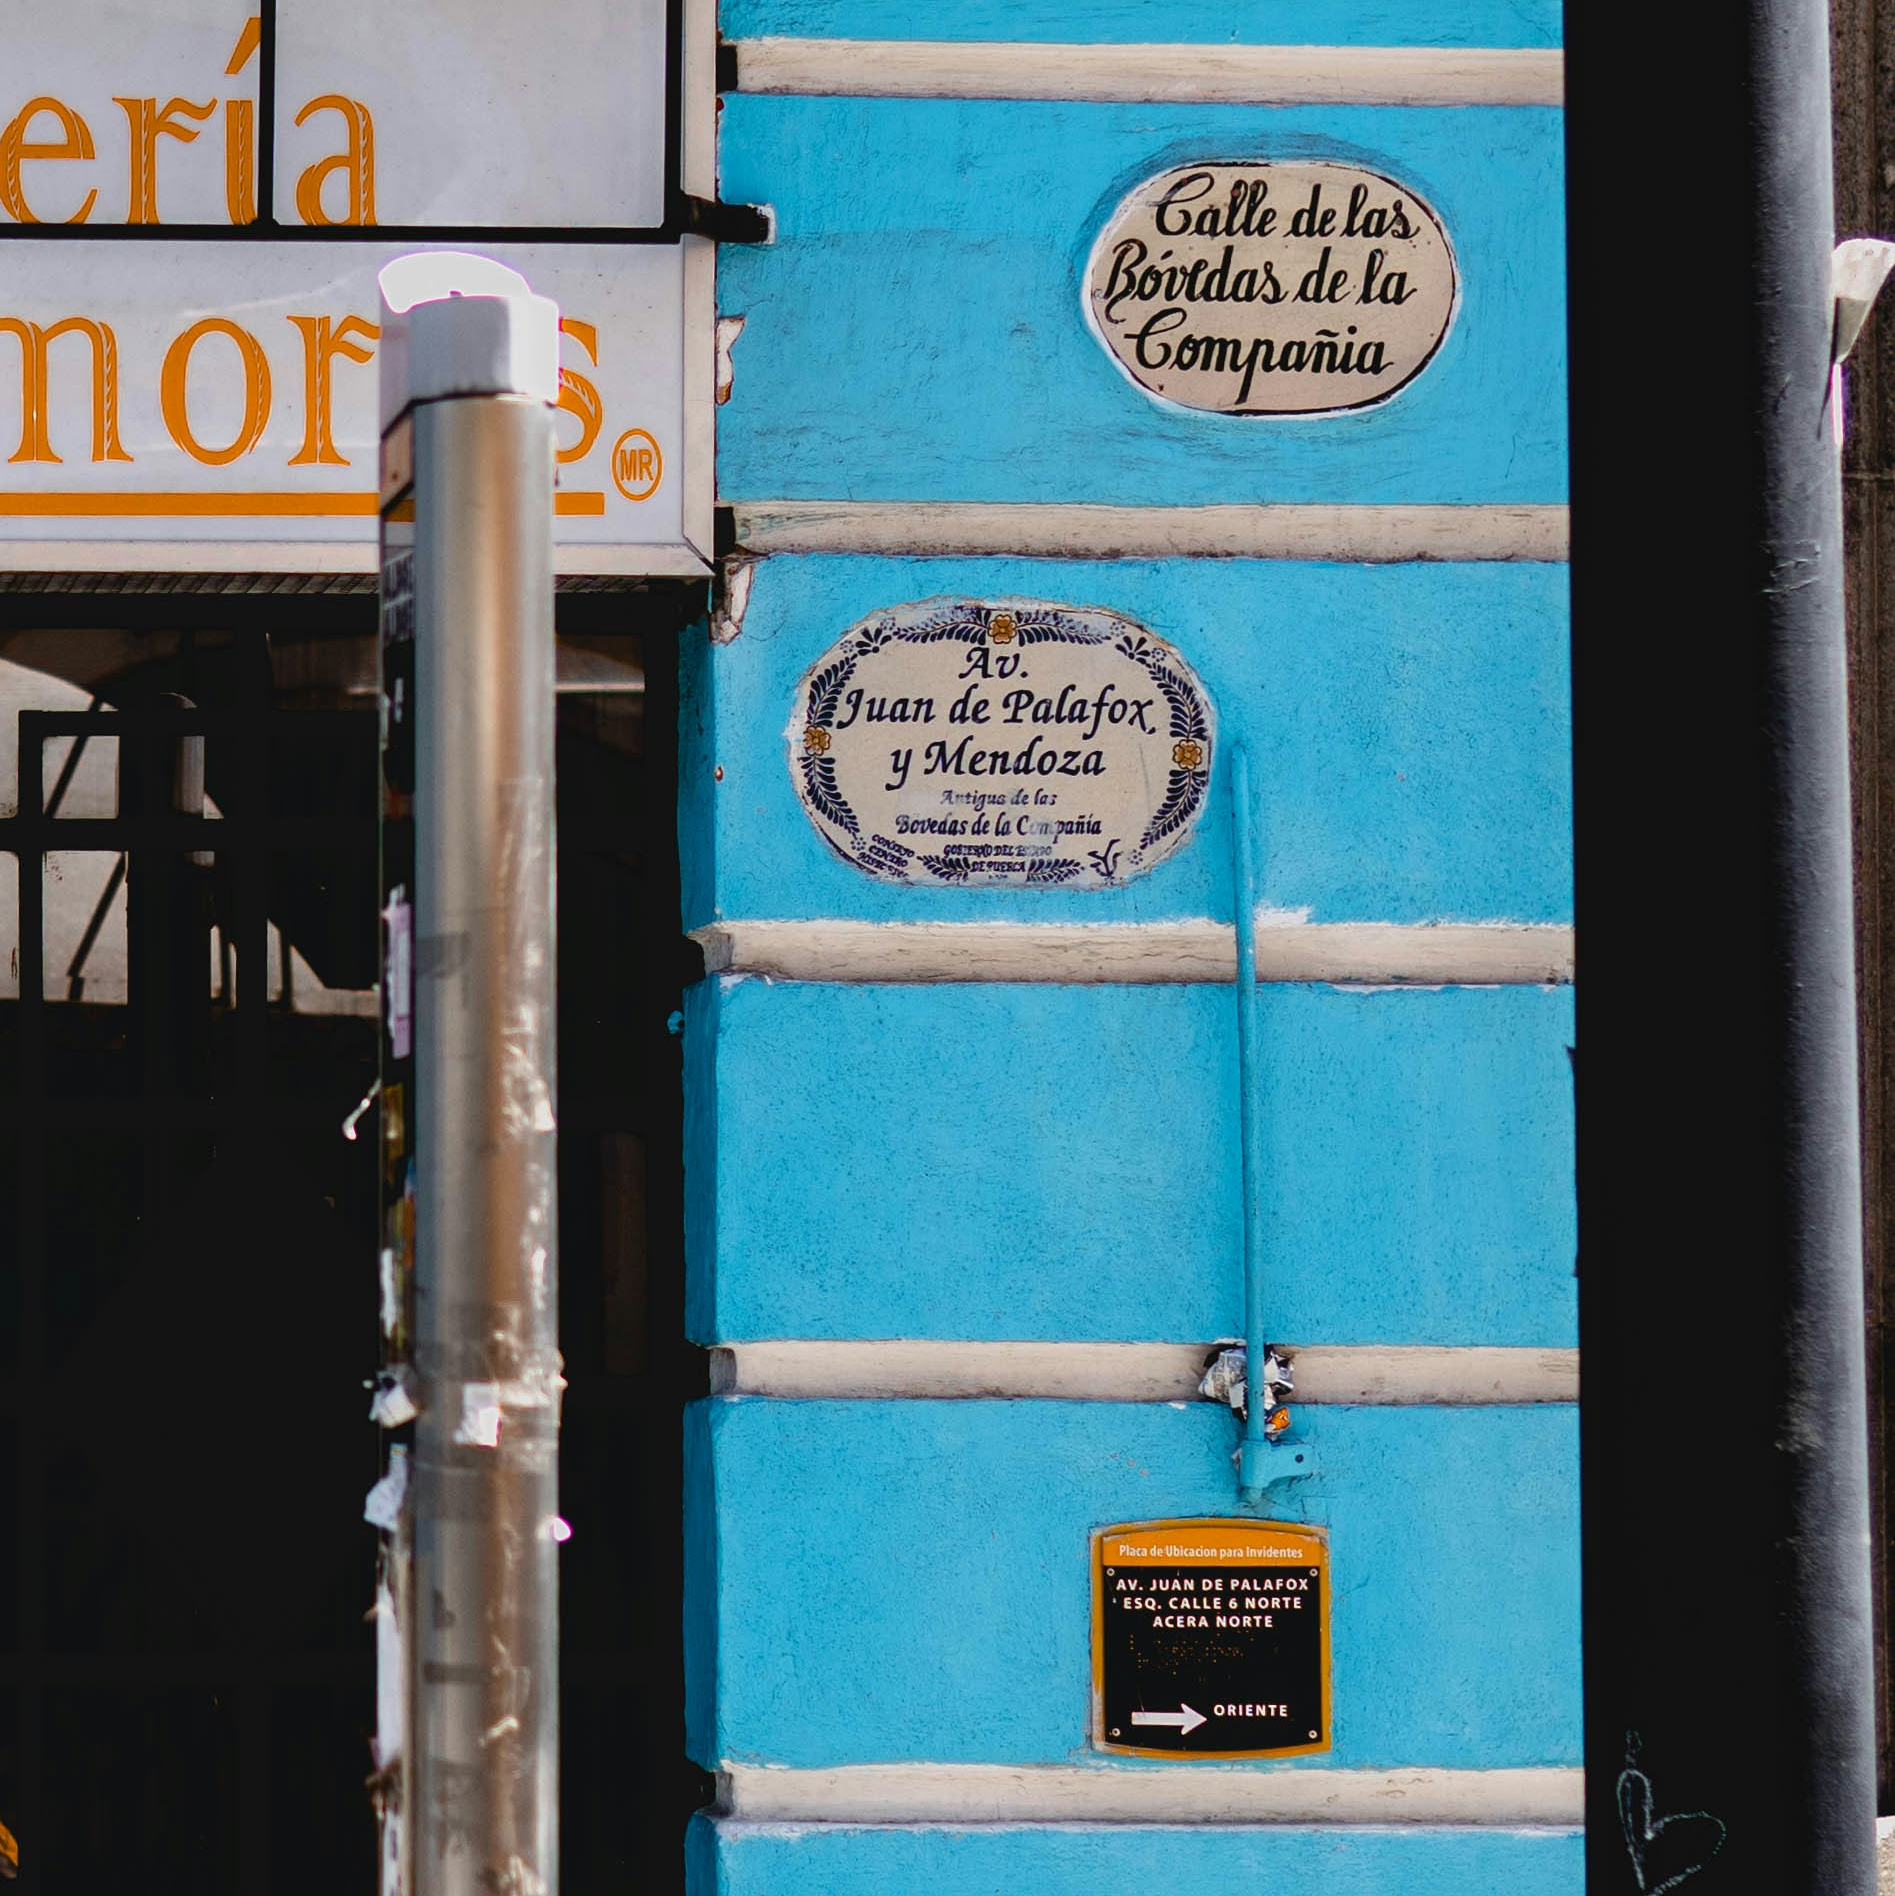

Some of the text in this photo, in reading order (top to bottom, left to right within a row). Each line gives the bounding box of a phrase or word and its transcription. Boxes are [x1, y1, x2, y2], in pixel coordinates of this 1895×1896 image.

[1146, 172, 1421, 241] Calle de las
[1104, 238, 1417, 323] Bóvedas de la
[620, 446, 655, 483] MR
[958, 646, 1029, 680] Av.
[836, 683, 1157, 740] Juan de Palafox
[885, 735, 1107, 791] y Mendoza
[1011, 788, 1030, 806] de
[1034, 788, 1058, 806] las
[971, 812, 991, 836] de
[994, 811, 1013, 836] la
[869, 845, 908, 867] CENTRO
[994, 844, 1014, 857] DEL
[970, 861, 986, 873] DE
[1119, 1544, 1303, 1560] Placa de Ubicacion para Invidentes
[1116, 1579, 1308, 1591] AV. JUAN DE PALAFOX
[1123, 1597, 1302, 1611] ESQ. CALLE 6 NORTE
[1153, 1615, 1273, 1628] ACERA NORTE
[1213, 1704, 1288, 1718] ORIENTE
